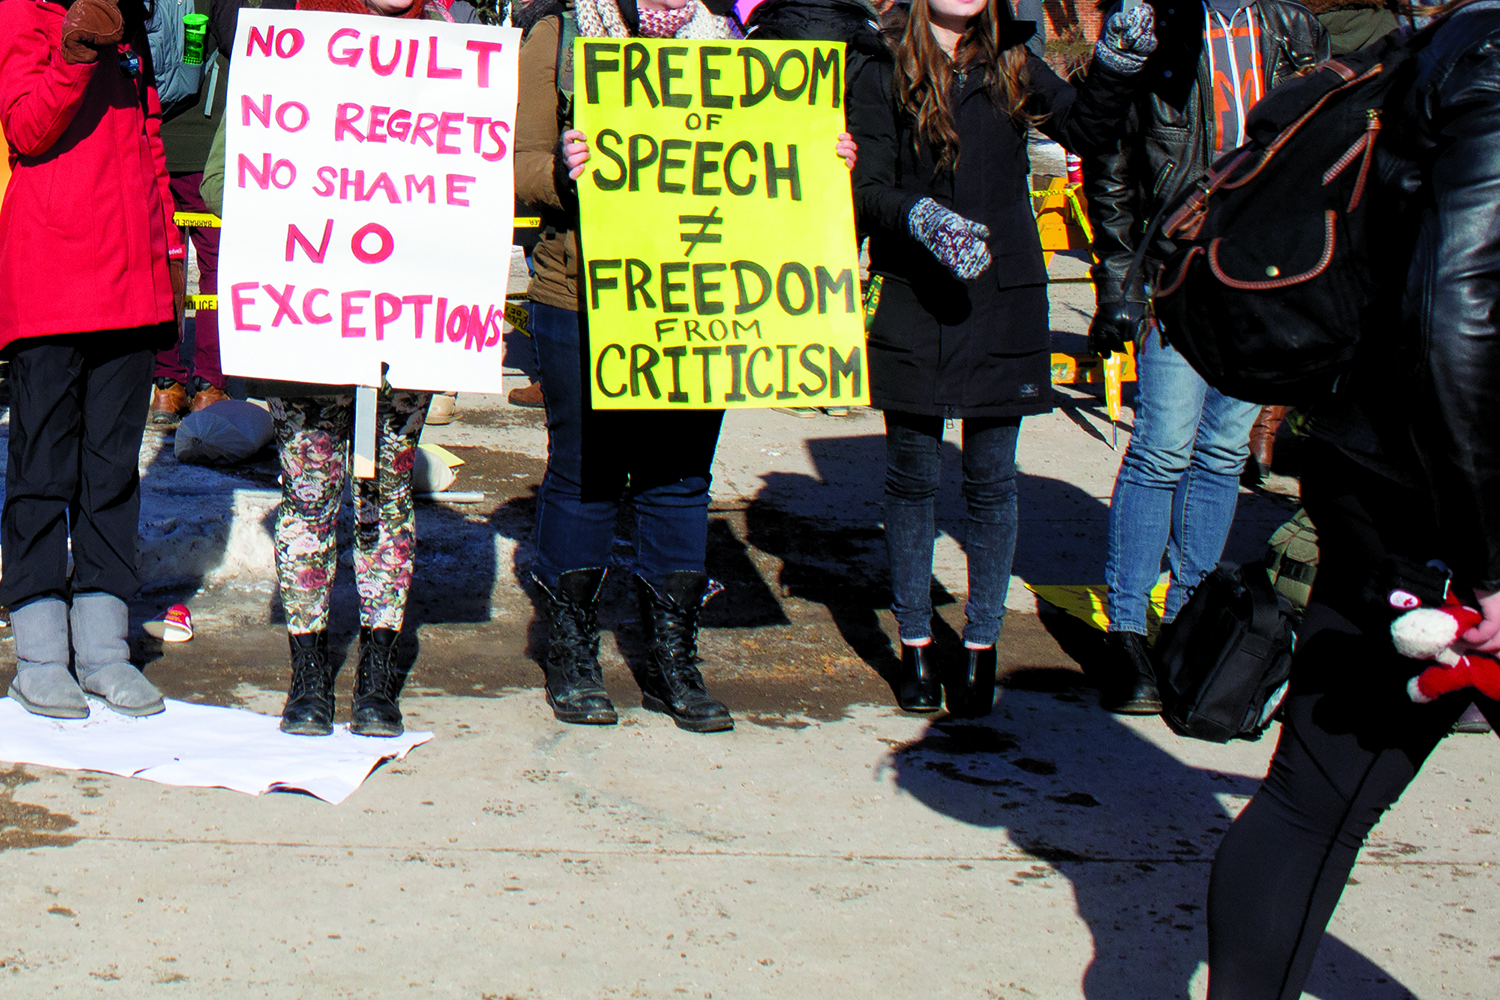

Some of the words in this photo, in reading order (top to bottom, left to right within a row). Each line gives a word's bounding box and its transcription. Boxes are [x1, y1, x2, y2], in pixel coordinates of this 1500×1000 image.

[246, 24, 305, 60] NO
[327, 27, 503, 89] GUILT
[583, 42, 841, 109] FREEDOM
[240, 94, 310, 133] NO
[334, 102, 510, 163] REGRETS
[685, 112, 724, 131] OF
[237, 152, 298, 190] NO
[312, 165, 477, 207] SHAME
[592, 128, 803, 201] SPEECH
[285, 218, 395, 264] NO
[230, 281, 502, 353] EXCEPTIONS
[587, 258, 857, 316] FREEDOM
[654, 318, 763, 342] FROM
[595, 343, 863, 404] CRITICISM
